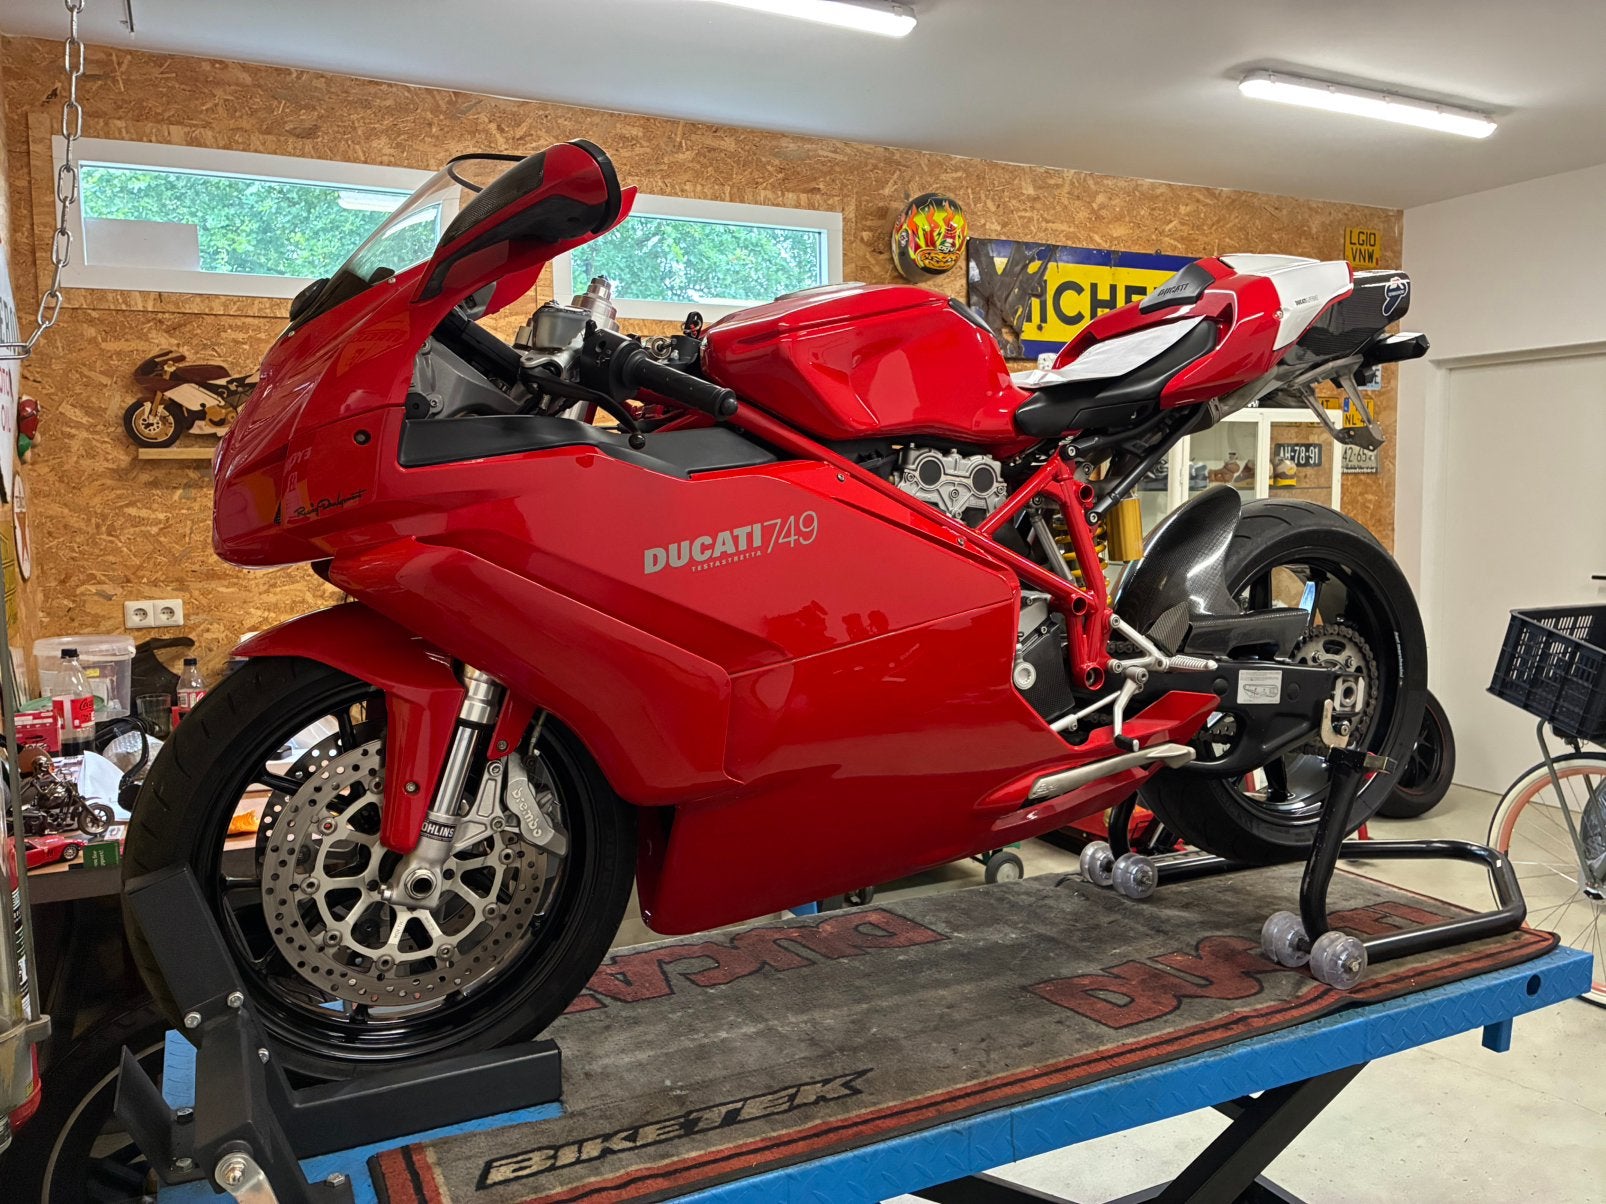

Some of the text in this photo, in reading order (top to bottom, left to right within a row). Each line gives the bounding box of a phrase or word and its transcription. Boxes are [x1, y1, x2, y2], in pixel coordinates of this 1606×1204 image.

[1349, 230, 1377, 247] LG10
[1351, 247, 1375, 264] VNW
[1157, 282, 1190, 297] DUCATI
[1280, 446, 1319, 464] AH-78-91
[643, 510, 819, 575] DUCATI 749
[690, 550, 763, 573] TESTASTRETTA
[512, 786, 543, 838] brembo
[475, 1067, 874, 1191] BIKETEK
